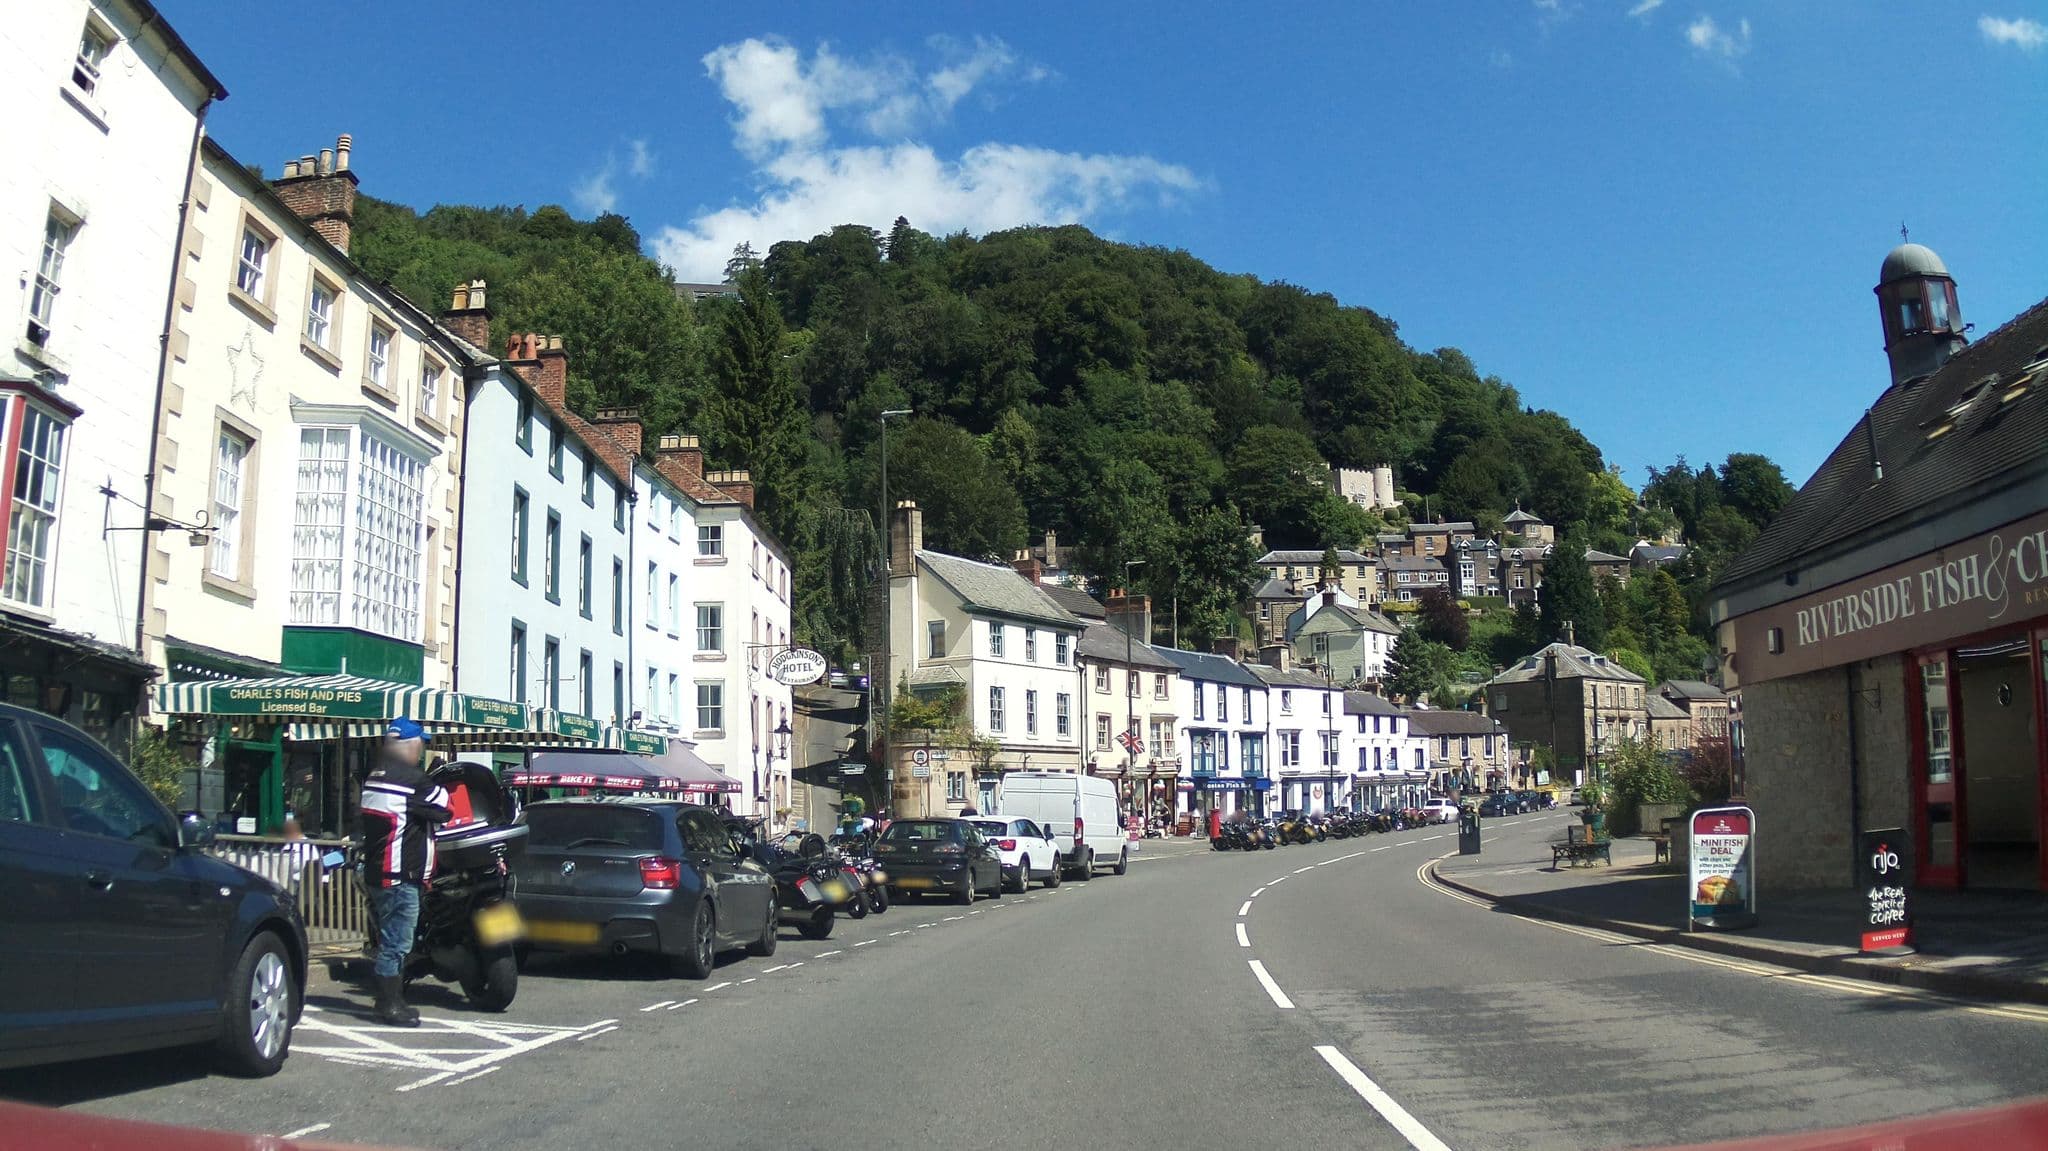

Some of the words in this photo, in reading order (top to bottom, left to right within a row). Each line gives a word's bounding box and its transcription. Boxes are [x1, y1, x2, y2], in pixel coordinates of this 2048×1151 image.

[1796, 576, 1915, 645] RIVERSIDE
[1920, 554, 1983, 612] FISH
[1983, 535, 2016, 619] &
[783, 662, 814, 672] HOTEL
[781, 674, 817, 683] ESTAURANT
[284, 689, 311, 699] FISH
[310, 690, 334, 701] AND
[336, 691, 362, 702] PIES
[262, 702, 306, 712] Licensed
[309, 703, 327, 714] Bar
[560, 775, 583, 784] BIKE
[584, 776, 594, 784] IT
[1711, 847, 1733, 855] DEAL
